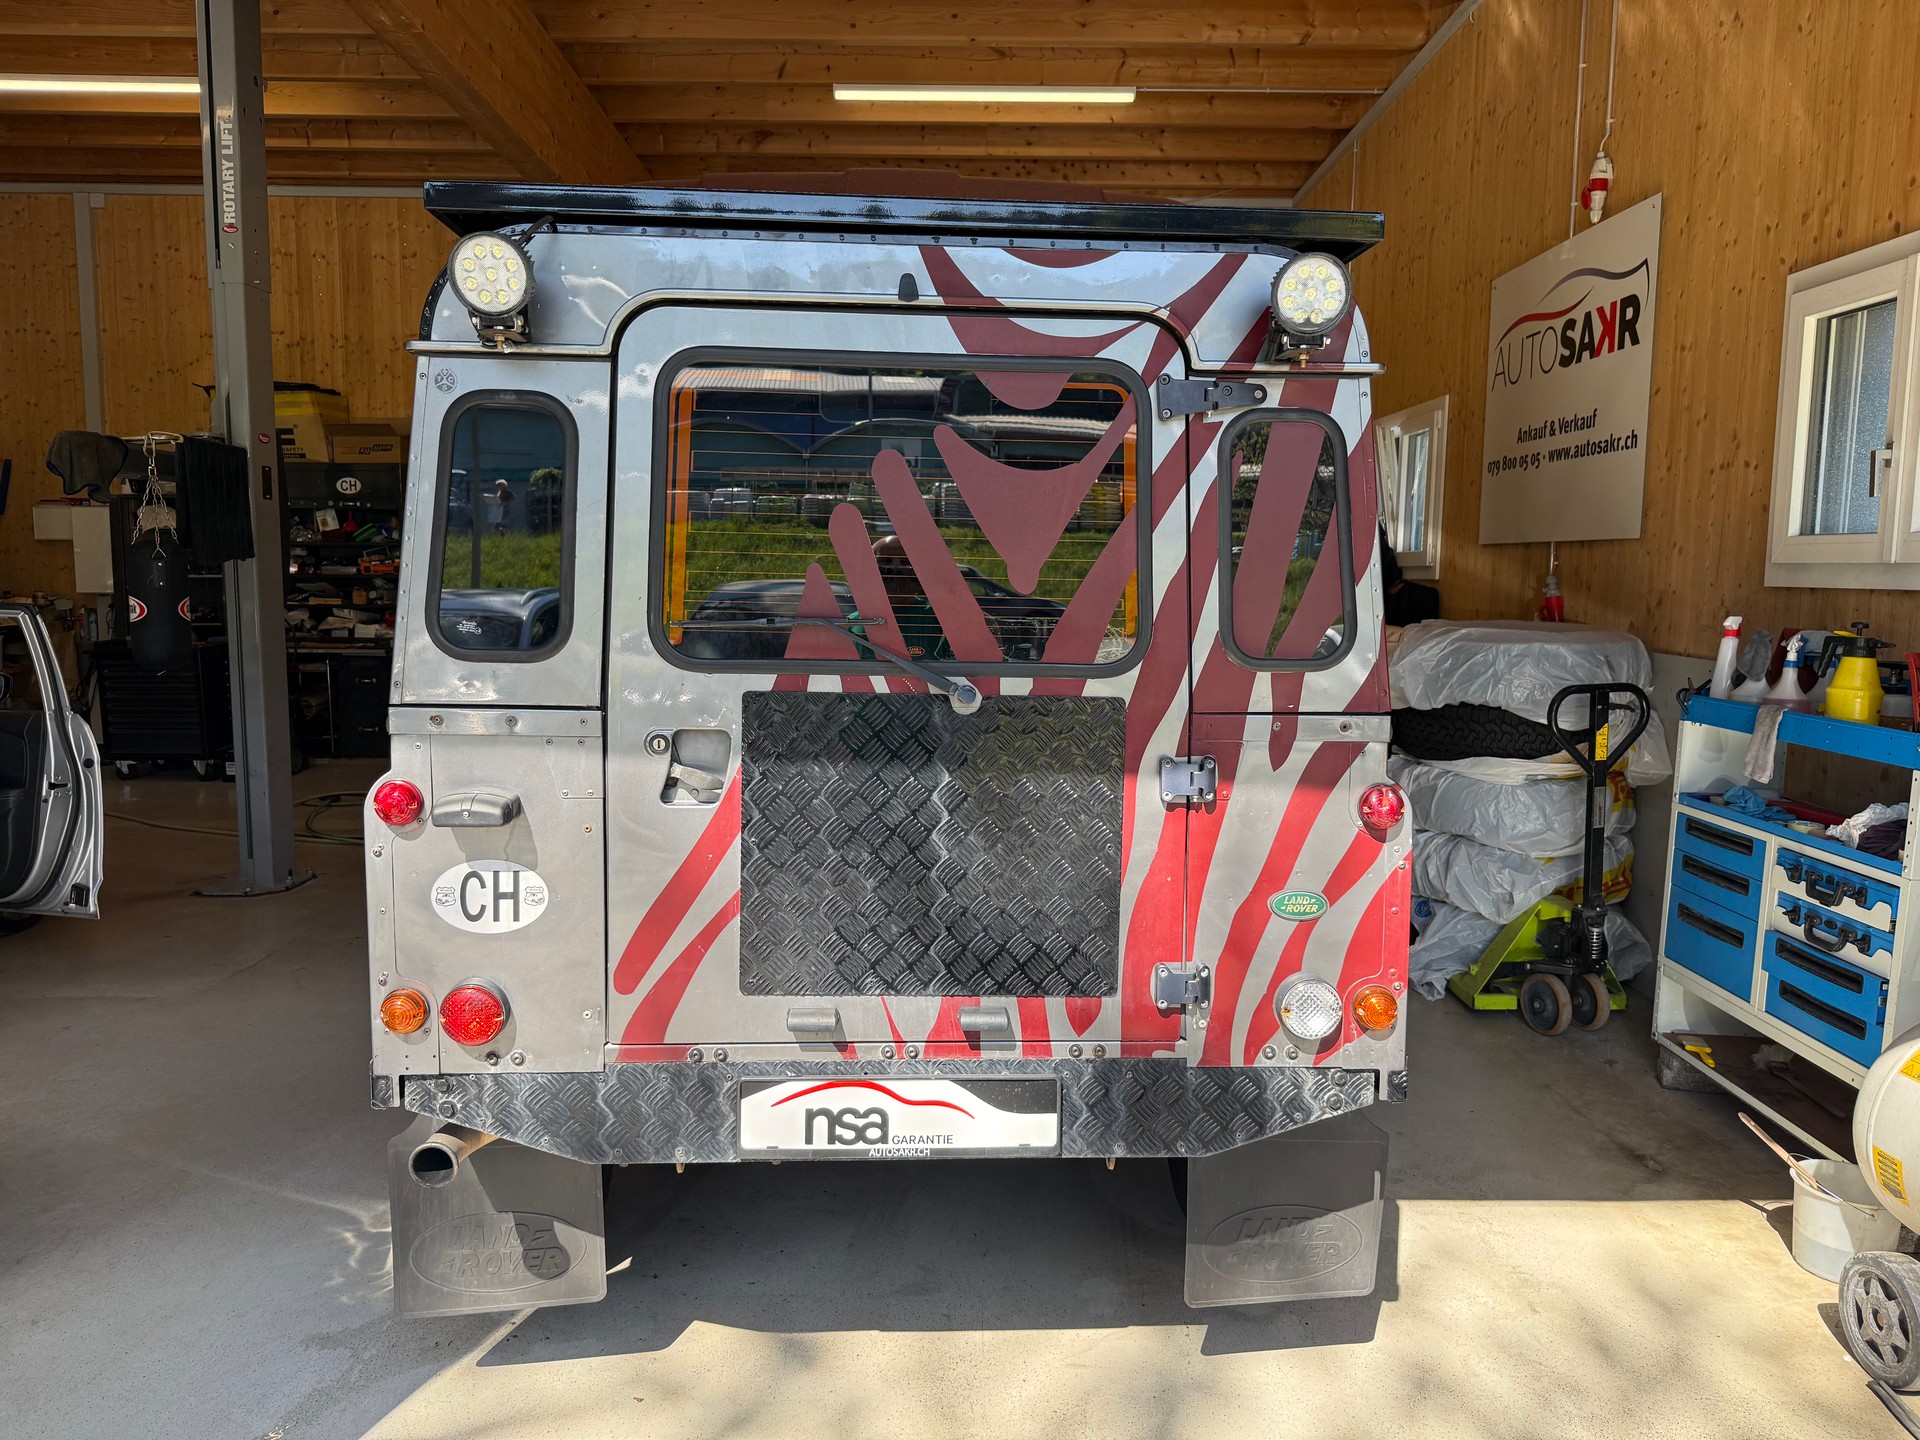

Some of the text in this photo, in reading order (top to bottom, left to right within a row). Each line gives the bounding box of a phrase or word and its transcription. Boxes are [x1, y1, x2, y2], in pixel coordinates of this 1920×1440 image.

[220, 120, 234, 155] LIFT
[222, 159, 236, 224] ROTARY
[1491, 293, 1641, 393] AUTOSAKR
[1516, 408, 1598, 444] Ankauf & Verkauf
[1487, 459, 1500, 477] 079
[1501, 455, 1517, 471] 800
[1518, 453, 1529, 471] 05
[1530, 452, 1541, 470] 05
[1548, 428, 1639, 463] www.autosakr.ch
[340, 480, 358, 491] CH
[459, 870, 521, 923] CH
[1283, 896, 1310, 905] LAND
[1285, 904, 1319, 913] ROVER
[804, 1106, 891, 1146] nsa
[891, 1134, 954, 1145] GARANTIE
[868, 1147, 931, 1158] AUTOSAKR.CH
[450, 1223, 531, 1252] LAND
[453, 1246, 565, 1279] ROVER
